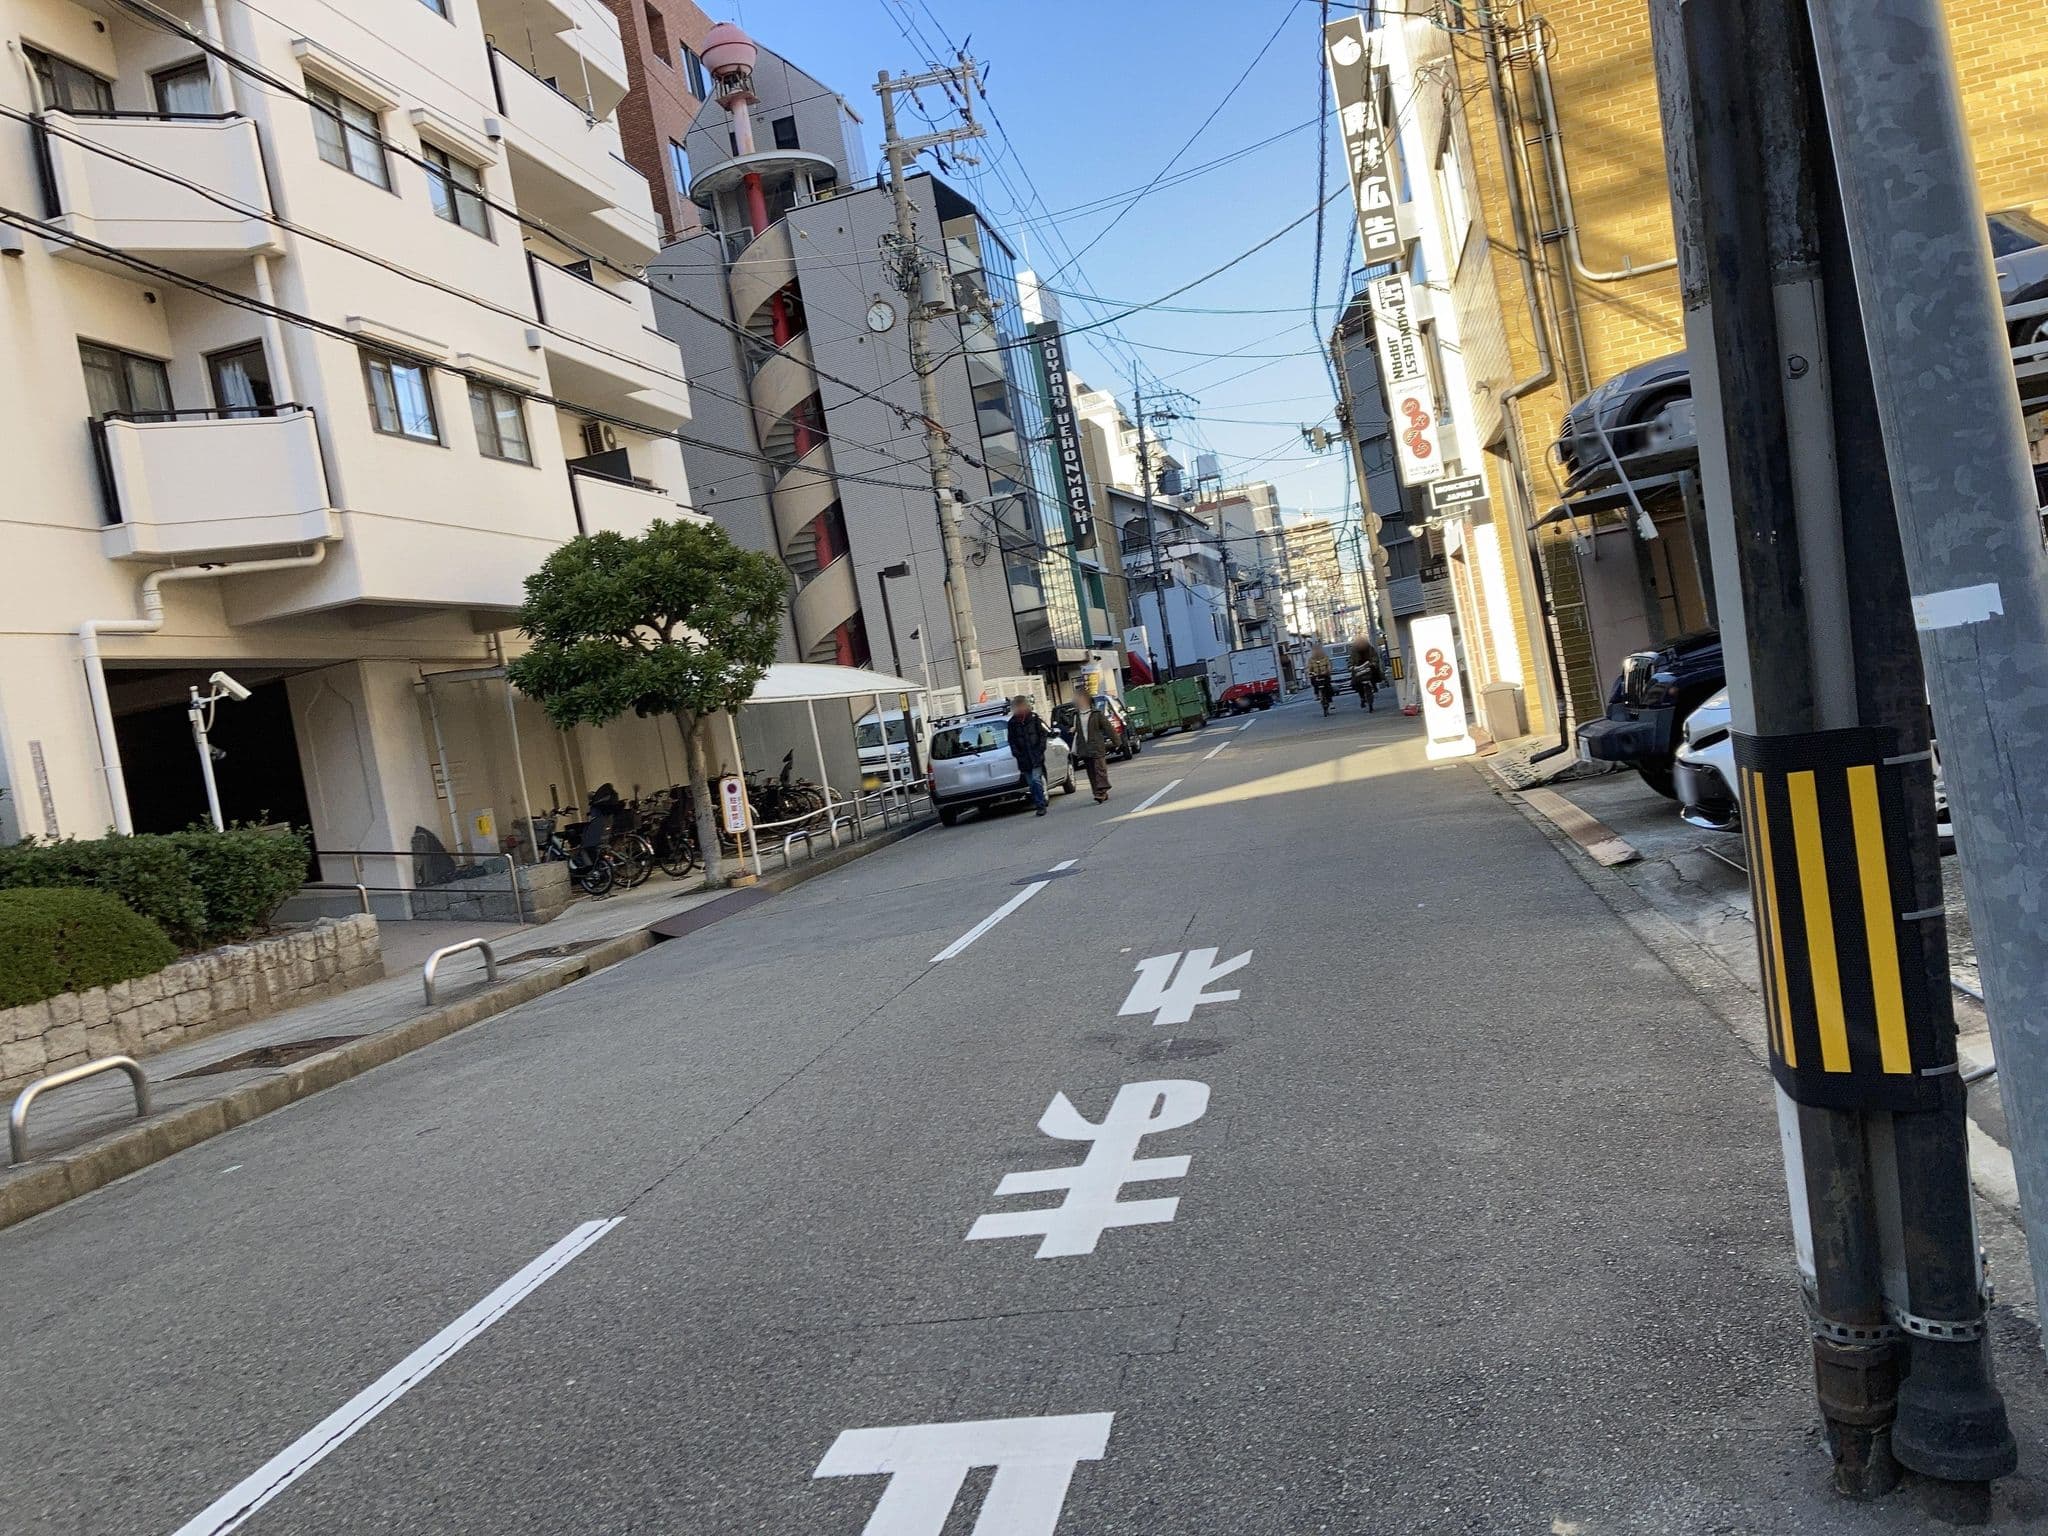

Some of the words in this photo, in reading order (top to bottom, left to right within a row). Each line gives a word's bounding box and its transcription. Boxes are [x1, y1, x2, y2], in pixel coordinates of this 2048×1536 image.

[1387, 336, 1404, 380] JAPAN
[1396, 307, 1418, 375] MONCREST
[1056, 412, 1089, 535] UEHONMACHI
